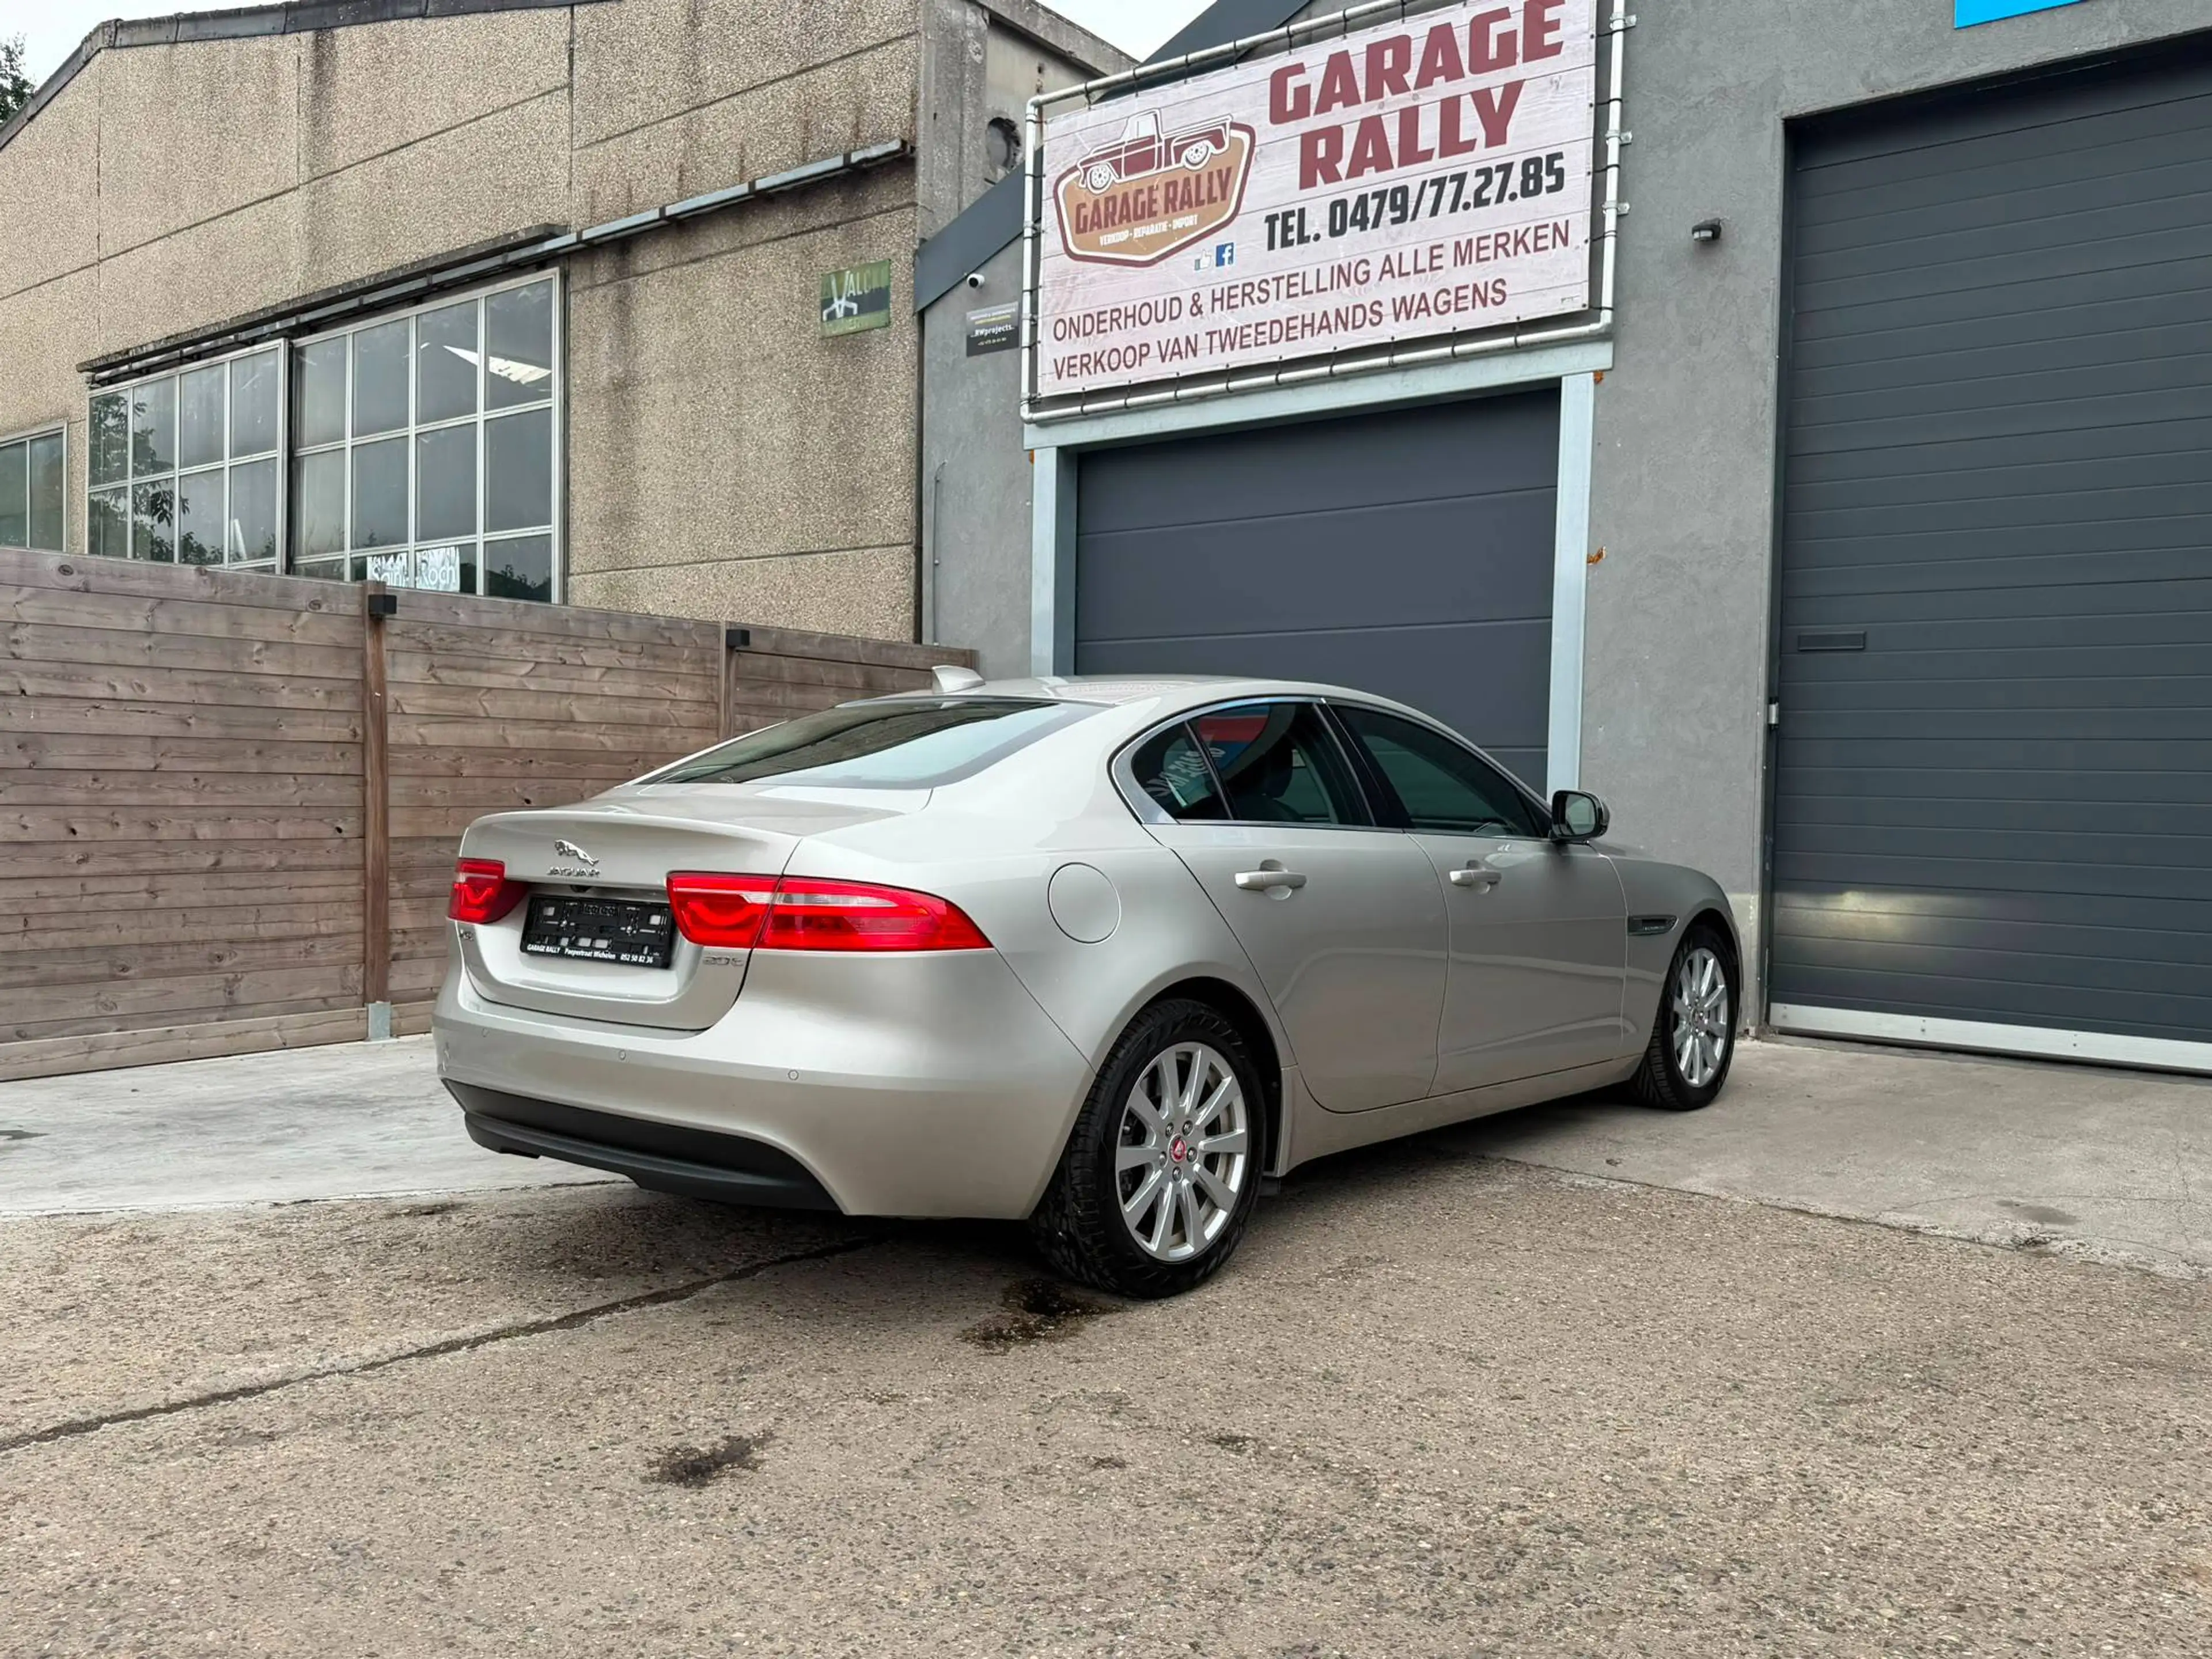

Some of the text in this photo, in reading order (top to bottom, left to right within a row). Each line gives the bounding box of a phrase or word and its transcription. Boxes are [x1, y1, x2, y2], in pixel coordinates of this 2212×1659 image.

[1270, 0, 1566, 126] GARAGE
[1299, 79, 1525, 191] RALLY
[1074, 166, 1232, 234] GARAGE RALLY
[1099, 230, 1130, 247] VERKOOP
[1172, 214, 1198, 230] IMPORT
[1264, 151, 1565, 251] TEL. 0479/77.27.85
[1054, 219, 1570, 342] ONDERHOUD & HERSTELLING ALLE MERKEN
[1054, 278, 1507, 381] VERKOOP VAN TWEEDEHANDS WAGENS
[547, 866, 601, 877] JAGUAR
